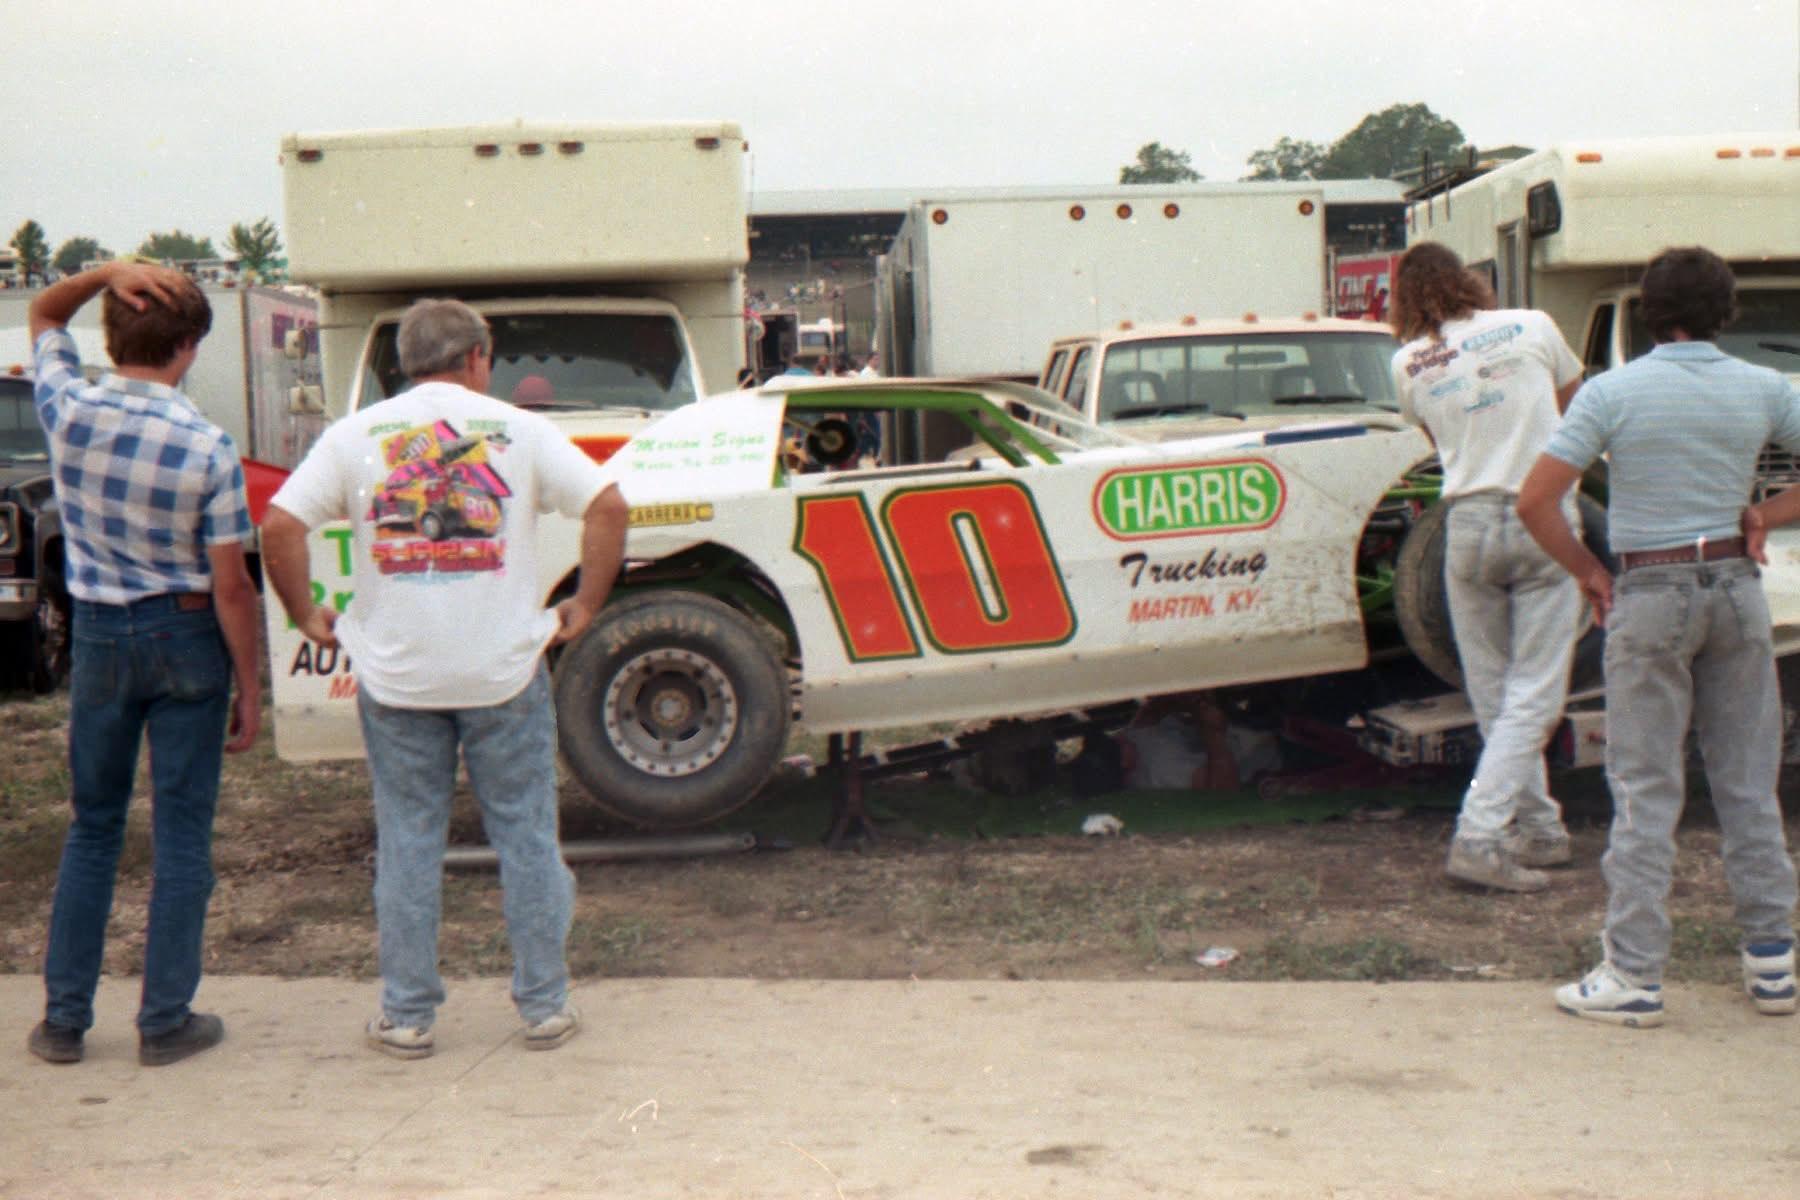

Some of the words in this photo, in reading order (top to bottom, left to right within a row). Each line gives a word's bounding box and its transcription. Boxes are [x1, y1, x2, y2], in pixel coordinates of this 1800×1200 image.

[1115, 467, 1267, 529] HARRIS
[792, 478, 1079, 664] 10
[1120, 548, 1268, 588] Trucking
